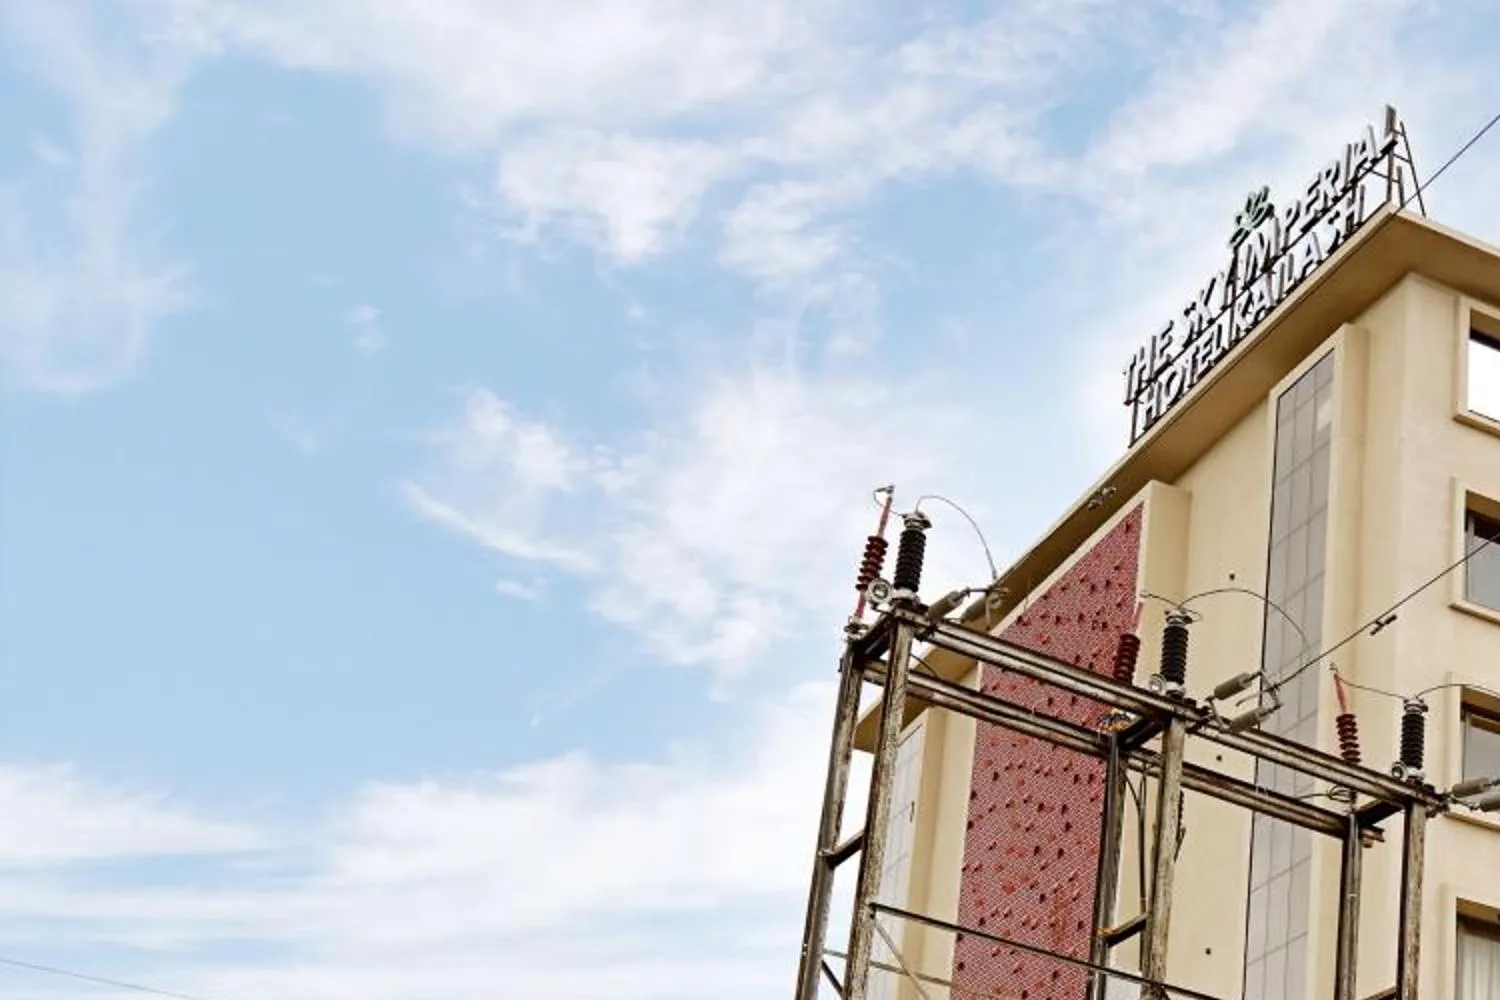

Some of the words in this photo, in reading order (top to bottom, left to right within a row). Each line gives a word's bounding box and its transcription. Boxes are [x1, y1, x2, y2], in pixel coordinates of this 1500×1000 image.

[1124, 320, 1173, 402] THE
[1142, 322, 1228, 432] HOTEL
[1234, 183, 1366, 346] KAILASH
